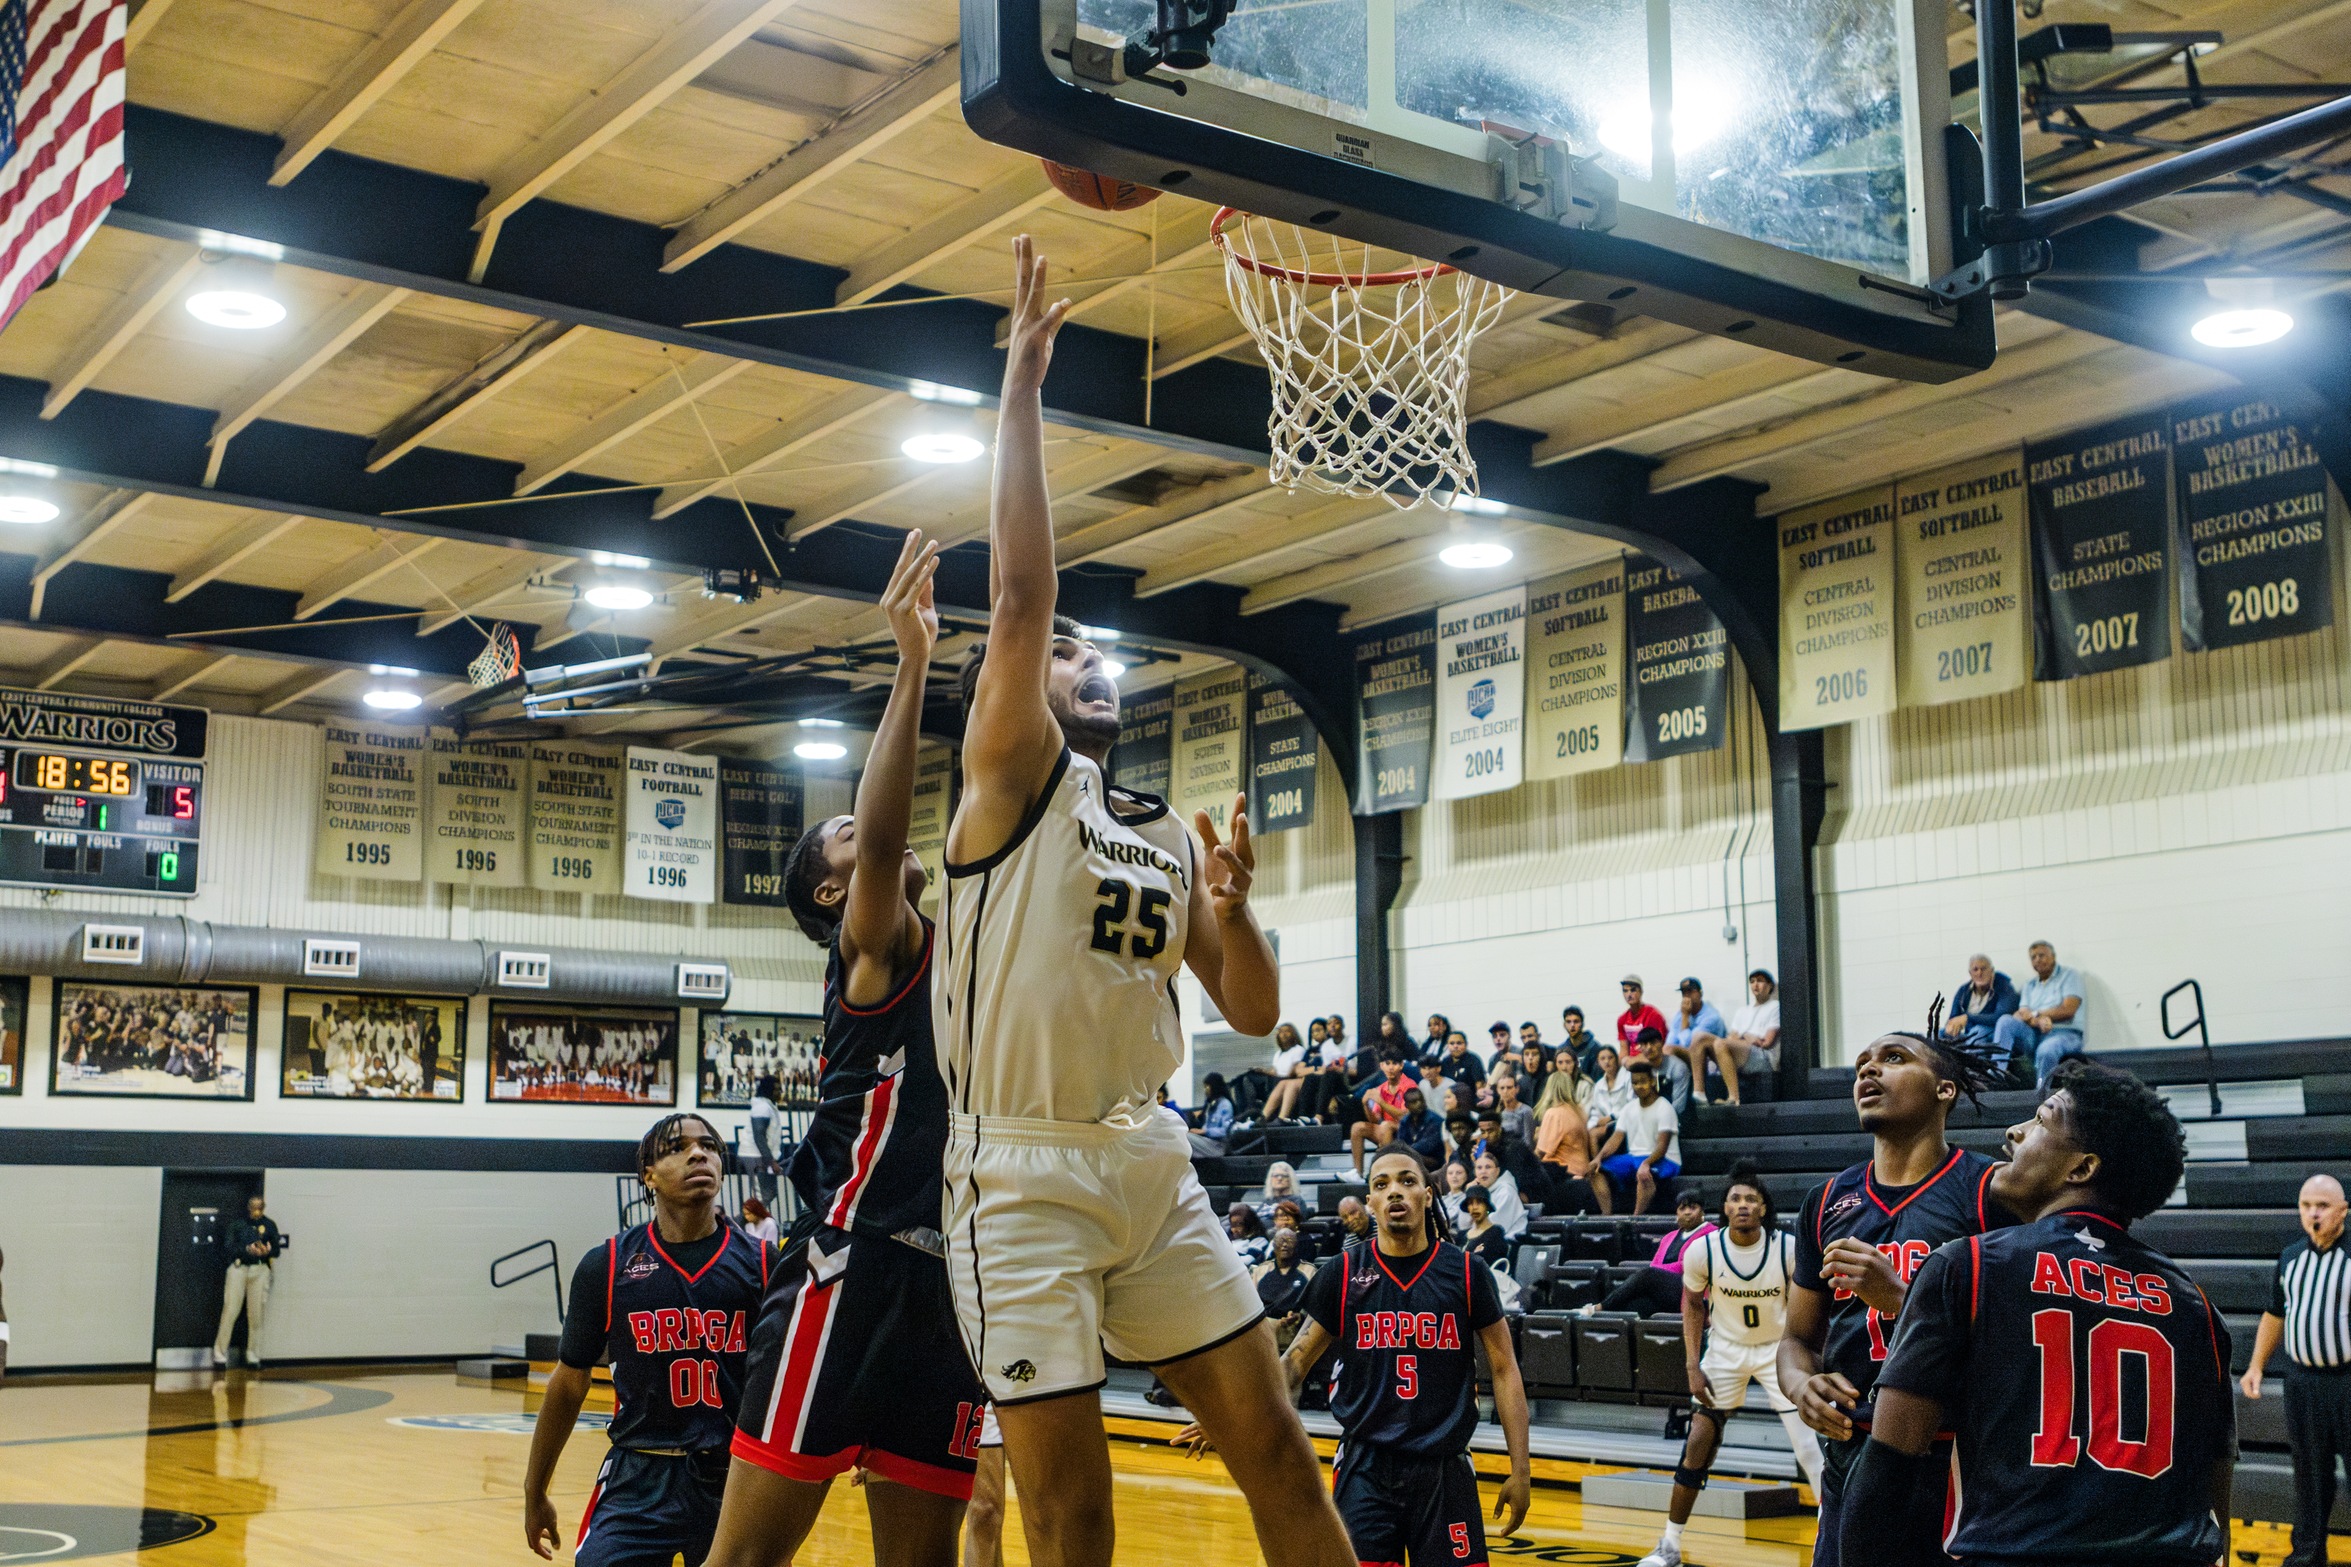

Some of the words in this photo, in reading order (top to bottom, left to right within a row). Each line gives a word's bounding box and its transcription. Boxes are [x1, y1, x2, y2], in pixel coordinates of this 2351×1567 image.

[2175, 411, 2224, 444] EAST
[2030, 454, 2075, 484] EAST
[2081, 431, 2167, 471] CENTRAL
[2204, 425, 2298, 469] WOMEN'S
[2190, 444, 2320, 494] BASKETBALL
[1901, 490, 1940, 517] EAST
[1946, 468, 2023, 504] CENTRAL
[2053, 467, 2145, 509] BASEBALL
[1783, 522, 1818, 548] EAST
[1824, 503, 1894, 537] CENTRAL
[1920, 504, 2003, 540] SOFTBALL
[2192, 505, 2270, 542] REGION
[2275, 492, 2324, 521] XXIII
[1800, 536, 1876, 571] SOFTBALL
[2073, 531, 2131, 561] STATE
[2197, 521, 2323, 567] CHAMPIONS
[1924, 546, 2002, 577] CENTRAL
[2050, 551, 2162, 592] CHAMPIONS
[1628, 568, 1662, 592] EAST
[1804, 576, 1875, 606] CENTRAL
[1926, 570, 2001, 603] DIVISION
[1531, 595, 1560, 615] EAST
[1565, 576, 1622, 606] CENTRAL
[1643, 585, 1701, 613] BASEBA
[2227, 577, 2299, 627] 2008
[1441, 618, 1470, 639] EAST
[1473, 603, 1525, 630] CENTRAL
[1544, 605, 1609, 636] SOFTBALL
[1806, 601, 1874, 630] DIVISION
[1915, 593, 2017, 629] CHAMPIONS
[1456, 632, 1508, 658] WOMEN'S
[1636, 635, 1689, 663] REGION
[1693, 628, 1727, 649] XXIII
[1796, 621, 1890, 656] CHAMPIONS
[2075, 612, 2139, 658] 2007
[1447, 646, 1520, 677] BASKETBALL
[1549, 642, 1607, 668] CENTRAL
[1640, 651, 1725, 684] CHAMPIONS
[1938, 641, 1993, 682] 2007
[1363, 669, 1431, 699] BASKETBALL
[1549, 664, 1606, 690] DIVISION
[1816, 668, 1867, 706] 2006
[1541, 683, 1618, 712] CHAMPIONS
[0, 703, 177, 751] WARRIORS
[326, 727, 360, 745] EAST
[366, 732, 423, 750] CENTRAL
[1450, 726, 1480, 745] ELITE
[1483, 717, 1519, 738] EIGHT
[1658, 705, 1707, 743] 2005
[533, 748, 563, 763] EAST
[1270, 737, 1300, 755] STATE
[1557, 724, 1599, 758] 2005
[144, 763, 200, 782] VISITOR
[331, 762, 414, 783] BASKETBALL
[345, 750, 405, 767] WOMEN'S
[629, 757, 659, 773] EAST
[663, 762, 715, 779] CENTRAL
[1256, 753, 1316, 777] CHAMPIONS
[1466, 746, 1504, 778] 2004
[37, 755, 130, 795] 18:56
[438, 772, 518, 791] BASKETBALL
[642, 778, 703, 796] FOOTBALL
[1378, 765, 1415, 797] 2004
[174, 787, 193, 819] 5
[328, 783, 373, 797] SOUTH
[377, 786, 416, 801] STATE
[456, 793, 500, 808] SOUTH
[537, 781, 614, 800] BASKETBALL
[1268, 788, 1303, 818] 2004
[43, 804, 84, 819] PERIOD
[100, 804, 107, 831] 1
[324, 799, 418, 818] TOURNAMENT
[449, 810, 506, 825] DIVISION
[534, 801, 576, 815] SOUTH
[579, 804, 615, 818] STATE
[136, 820, 173, 832] BONUS
[329, 817, 411, 834] CHAMPIONS
[438, 826, 515, 842] CHAMPIONS
[532, 816, 616, 834] TOURNAMENT
[34, 831, 77, 846] PLAYER
[87, 836, 121, 850] FOULS
[146, 839, 180, 853] FOULS
[346, 842, 390, 865] 1995
[536, 833, 611, 850] CHAMPIONS
[641, 834, 650, 844] IN
[654, 834, 673, 846] THE
[675, 836, 712, 850] NATION
[161, 852, 178, 881] 0
[456, 849, 496, 872] 1996
[552, 856, 592, 879] 1996
[659, 851, 699, 865] RECORD
[648, 866, 687, 888] 1996
[744, 873, 781, 895] 1997
[1090, 878, 1170, 960] 25
[623, 1262, 659, 1274] ACES
[1351, 1273, 1380, 1283] ACES
[1719, 1286, 1781, 1298] WARRIORS
[2030, 1252, 2172, 1316] ACES
[628, 1307, 747, 1354] BRPGA
[1356, 1311, 1461, 1349] BRPGA
[1743, 1304, 1760, 1328] 0
[670, 1358, 723, 1409] 00
[1396, 1355, 1418, 1399] 5
[2030, 1308, 2174, 1480] 10
[948, 1402, 985, 1460] 12
[1449, 1522, 1471, 1558] 5
